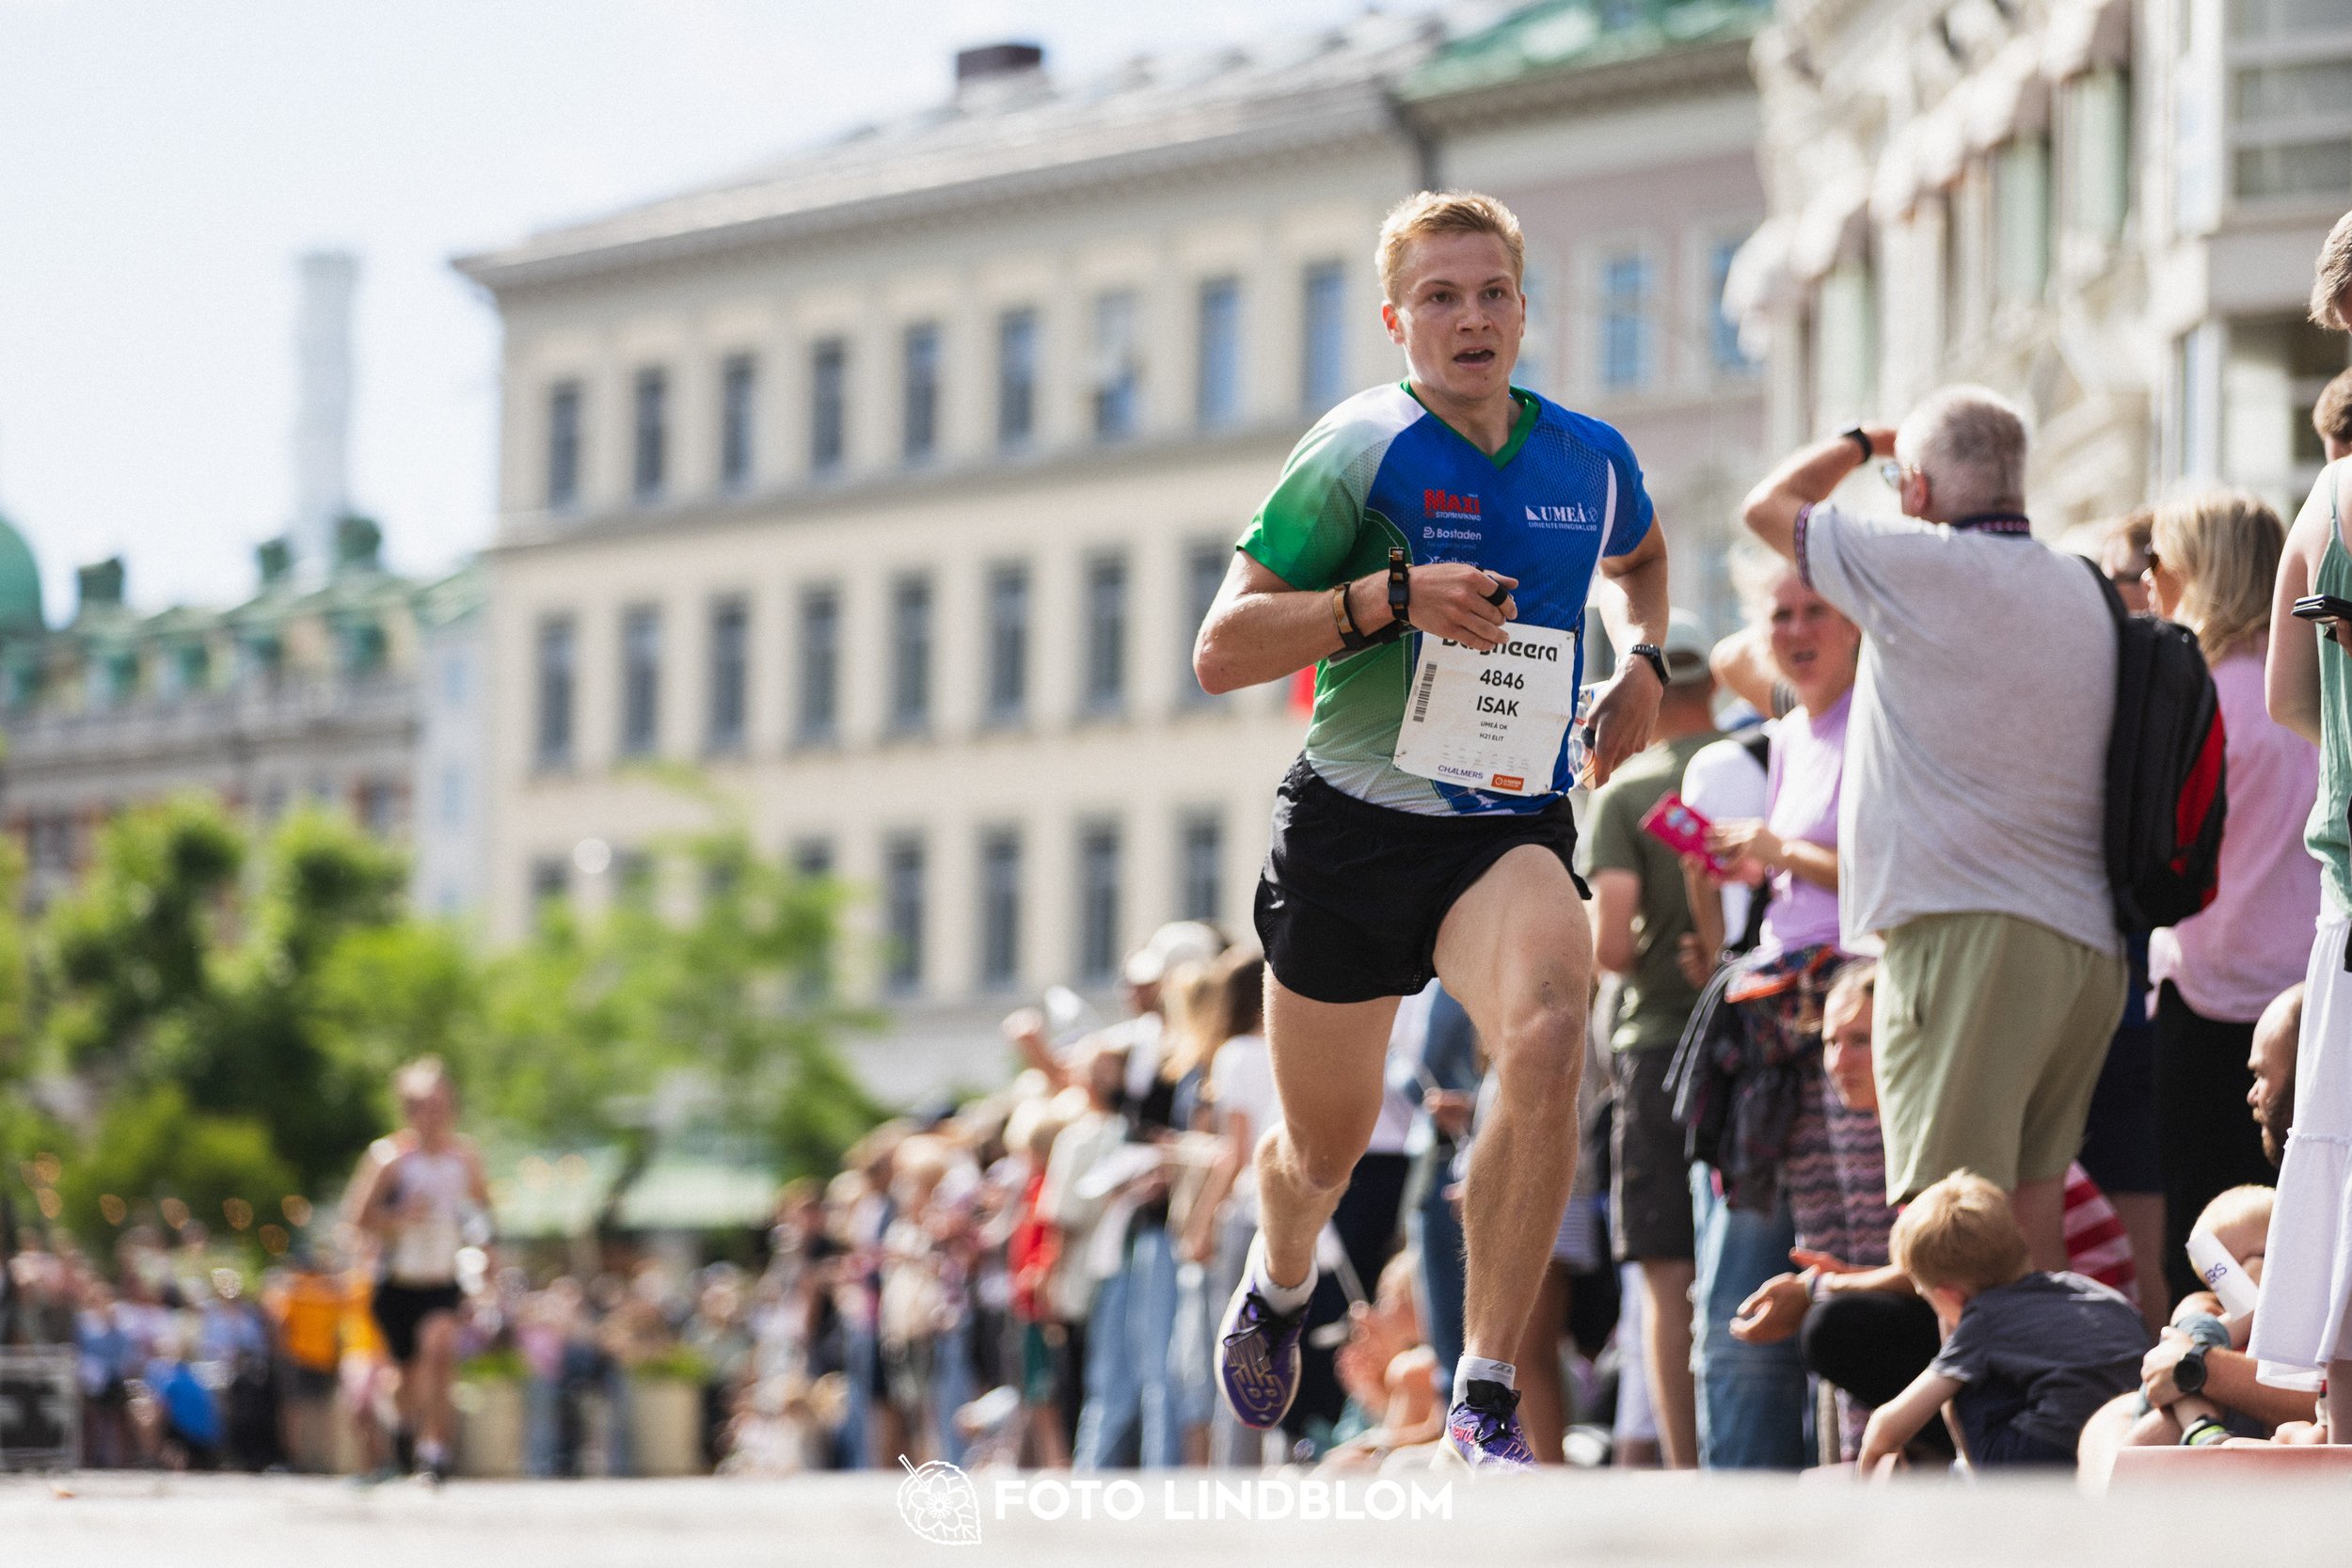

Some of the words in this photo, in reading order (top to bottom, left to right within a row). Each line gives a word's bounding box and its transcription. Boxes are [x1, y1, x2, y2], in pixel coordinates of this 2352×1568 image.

[1540, 502, 1587, 522] UMEÅ
[1480, 669, 1525, 690] 4846
[1476, 695, 1520, 718] ISAK
[1480, 721, 1498, 730] UMEÅ
[1491, 734, 1504, 742] ELIT
[1438, 765, 1484, 780] CHALMERS
